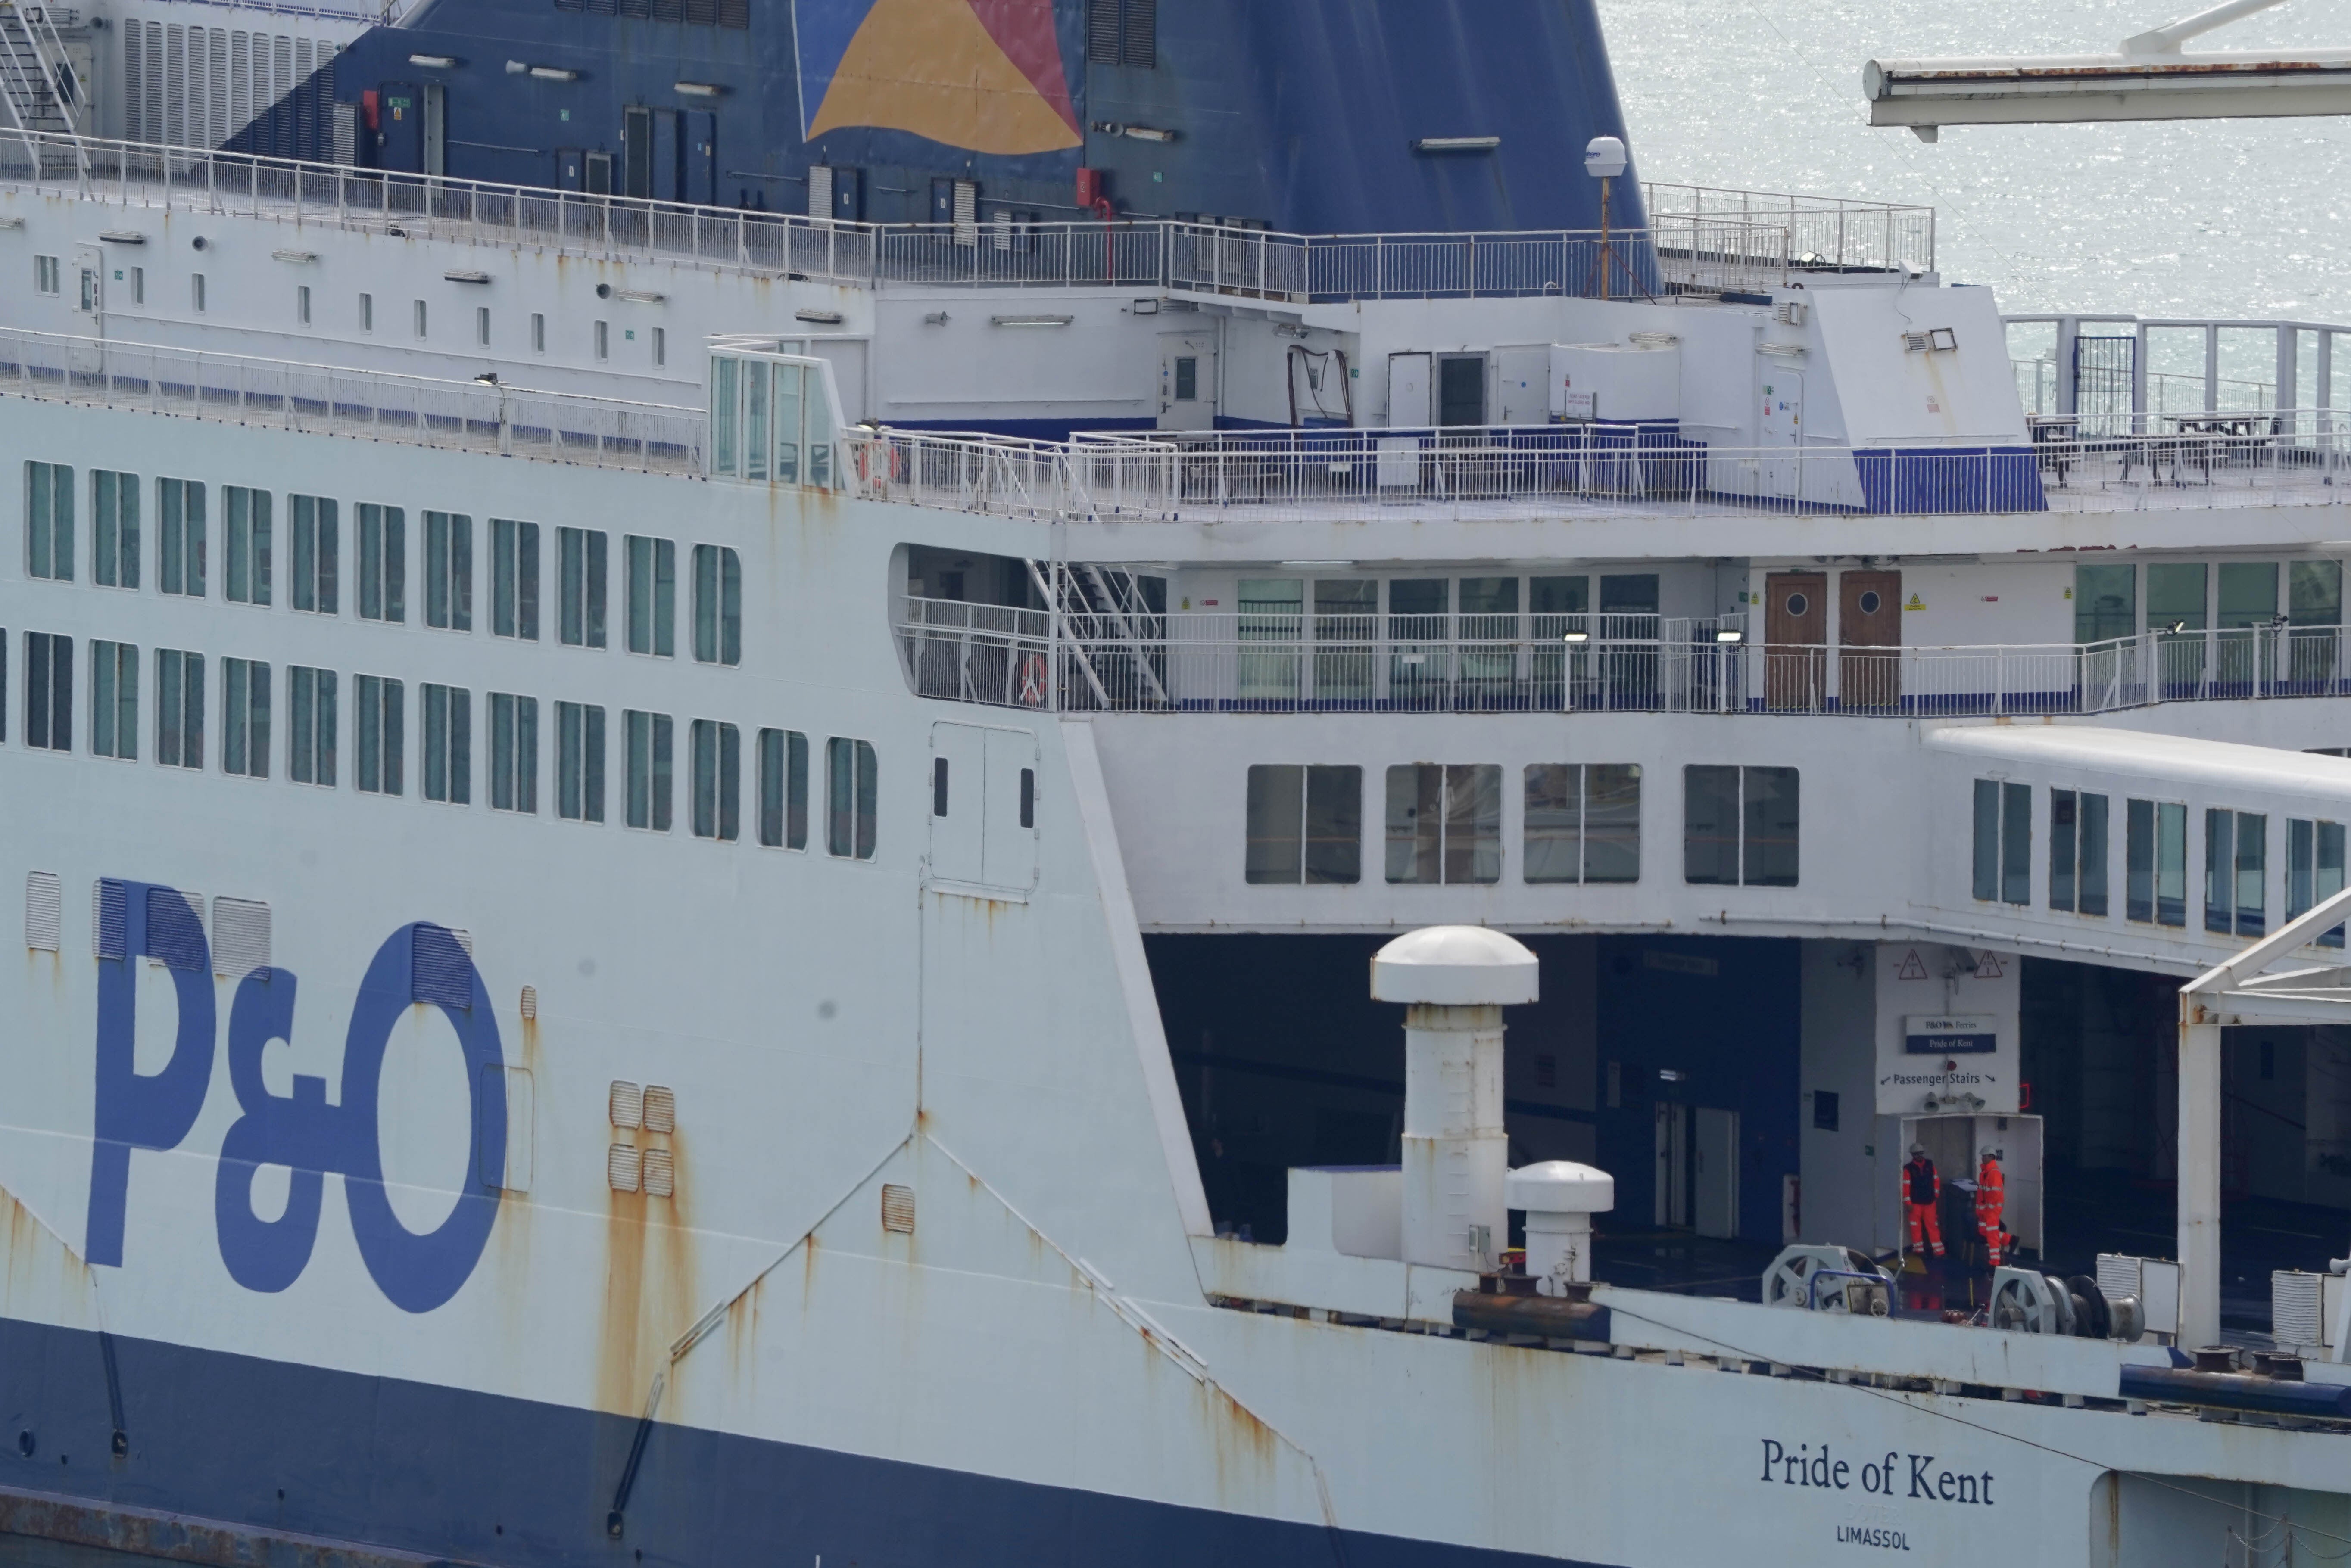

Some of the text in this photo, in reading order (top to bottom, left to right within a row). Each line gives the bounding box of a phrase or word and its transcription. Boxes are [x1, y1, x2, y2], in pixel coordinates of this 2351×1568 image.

[1929, 1039, 1947, 1048] Pride
[1949, 1039, 1956, 1047] of
[1894, 1073, 1980, 1086] Passenger Stairs
[85, 877, 507, 1314] P&O
[1761, 1439, 1994, 1505] Pride of Kent
[1837, 1525, 1910, 1551] LIMASSOL
